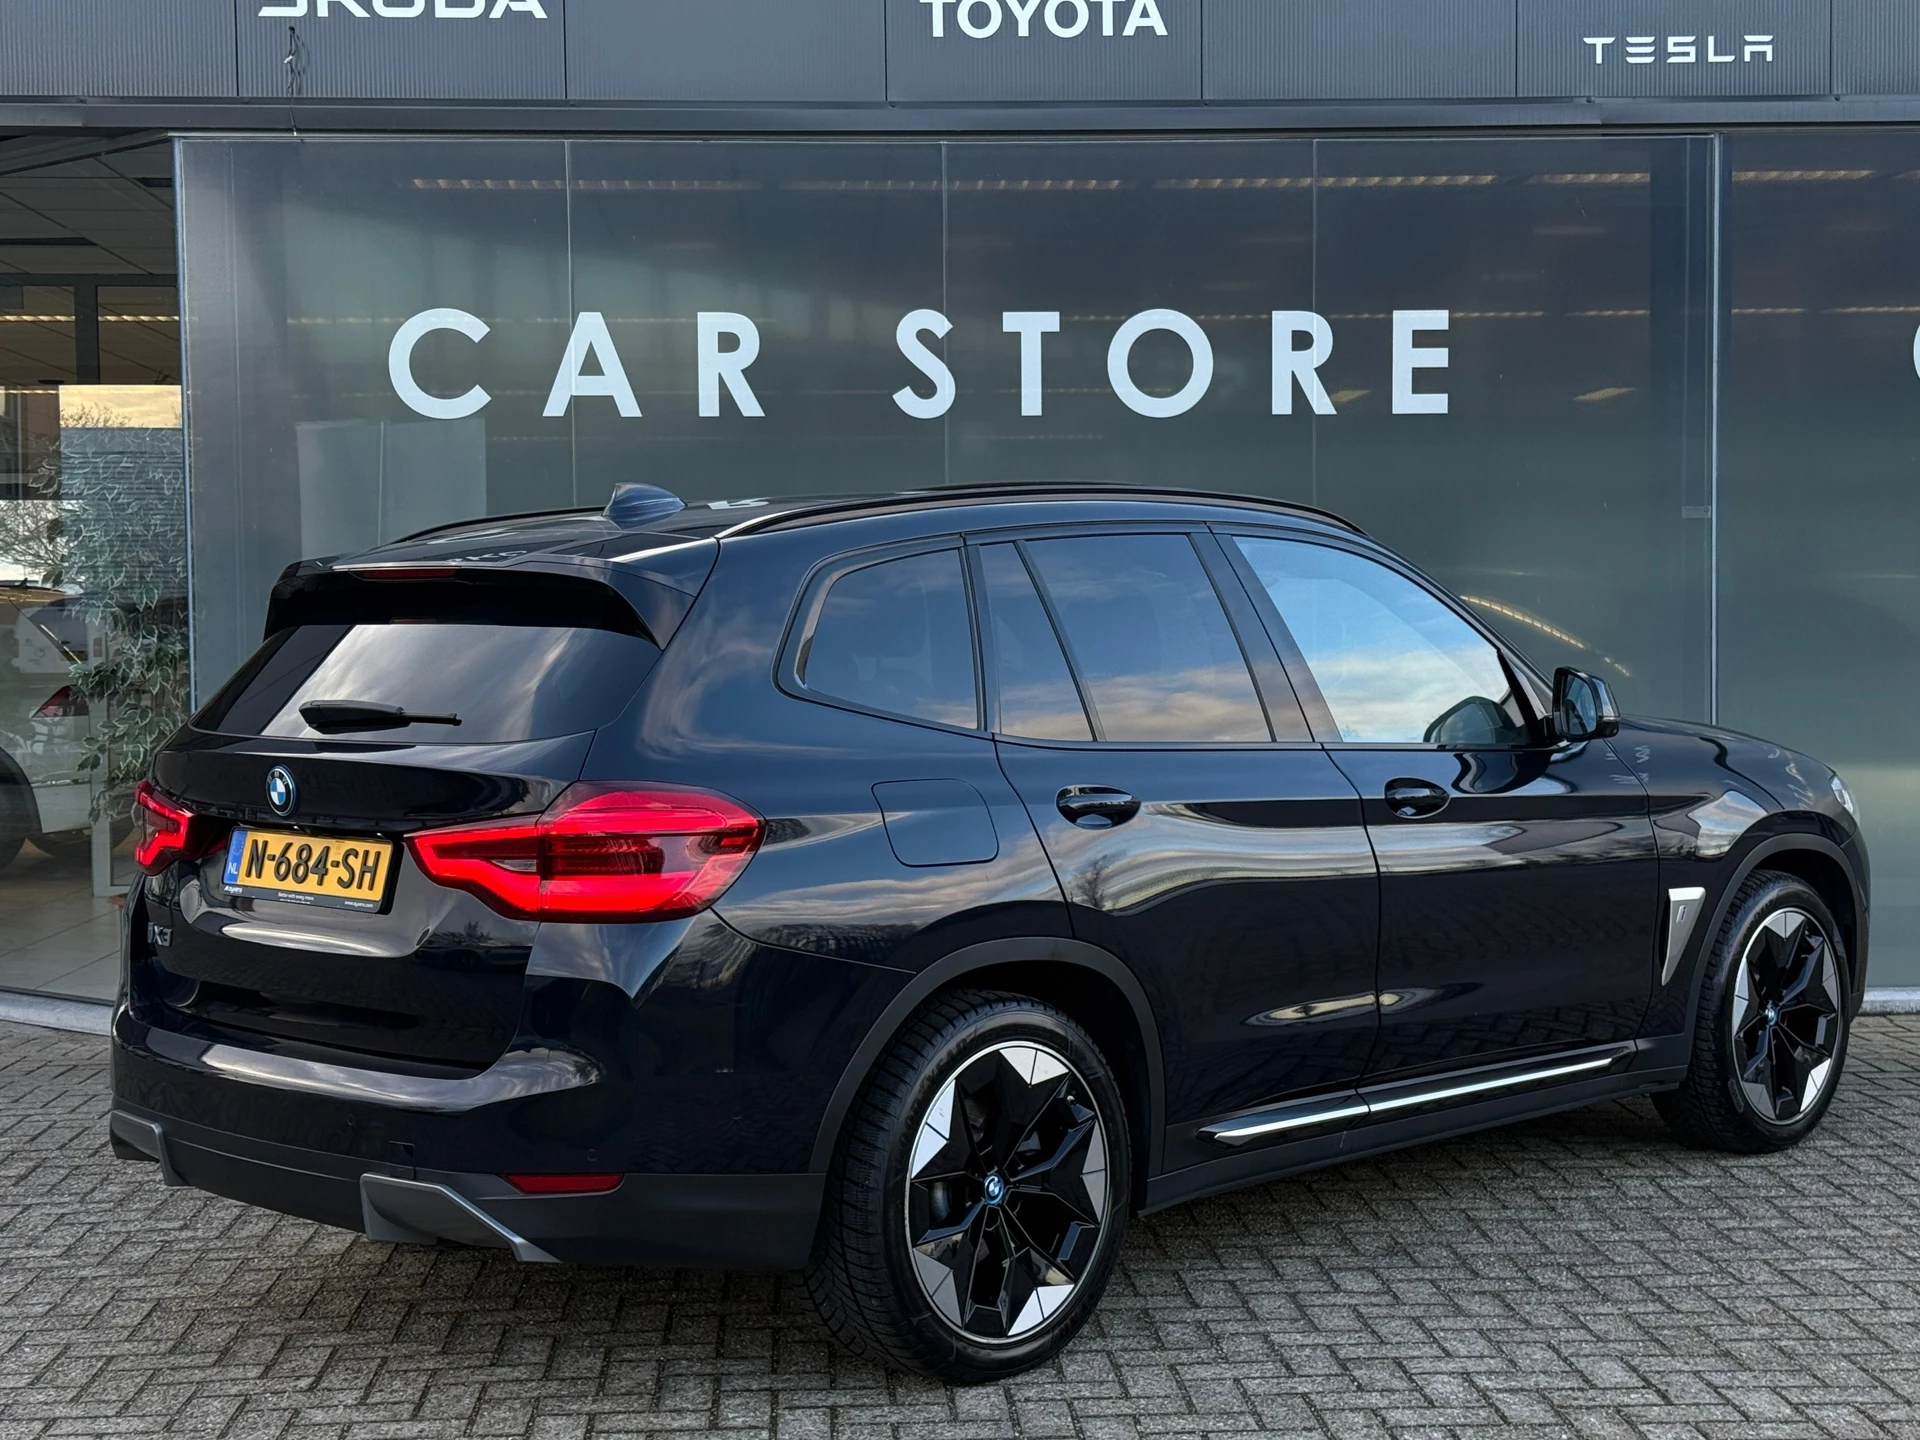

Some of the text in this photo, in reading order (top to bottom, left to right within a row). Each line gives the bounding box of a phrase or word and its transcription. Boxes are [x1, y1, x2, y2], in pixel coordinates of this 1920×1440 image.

[919, 0, 1168, 39] TOYOTA
[1583, 35, 1774, 64] TESLA
[388, 307, 1449, 420] CAR STORE
[227, 861, 238, 875] NL
[245, 839, 381, 891] N-684-SH
